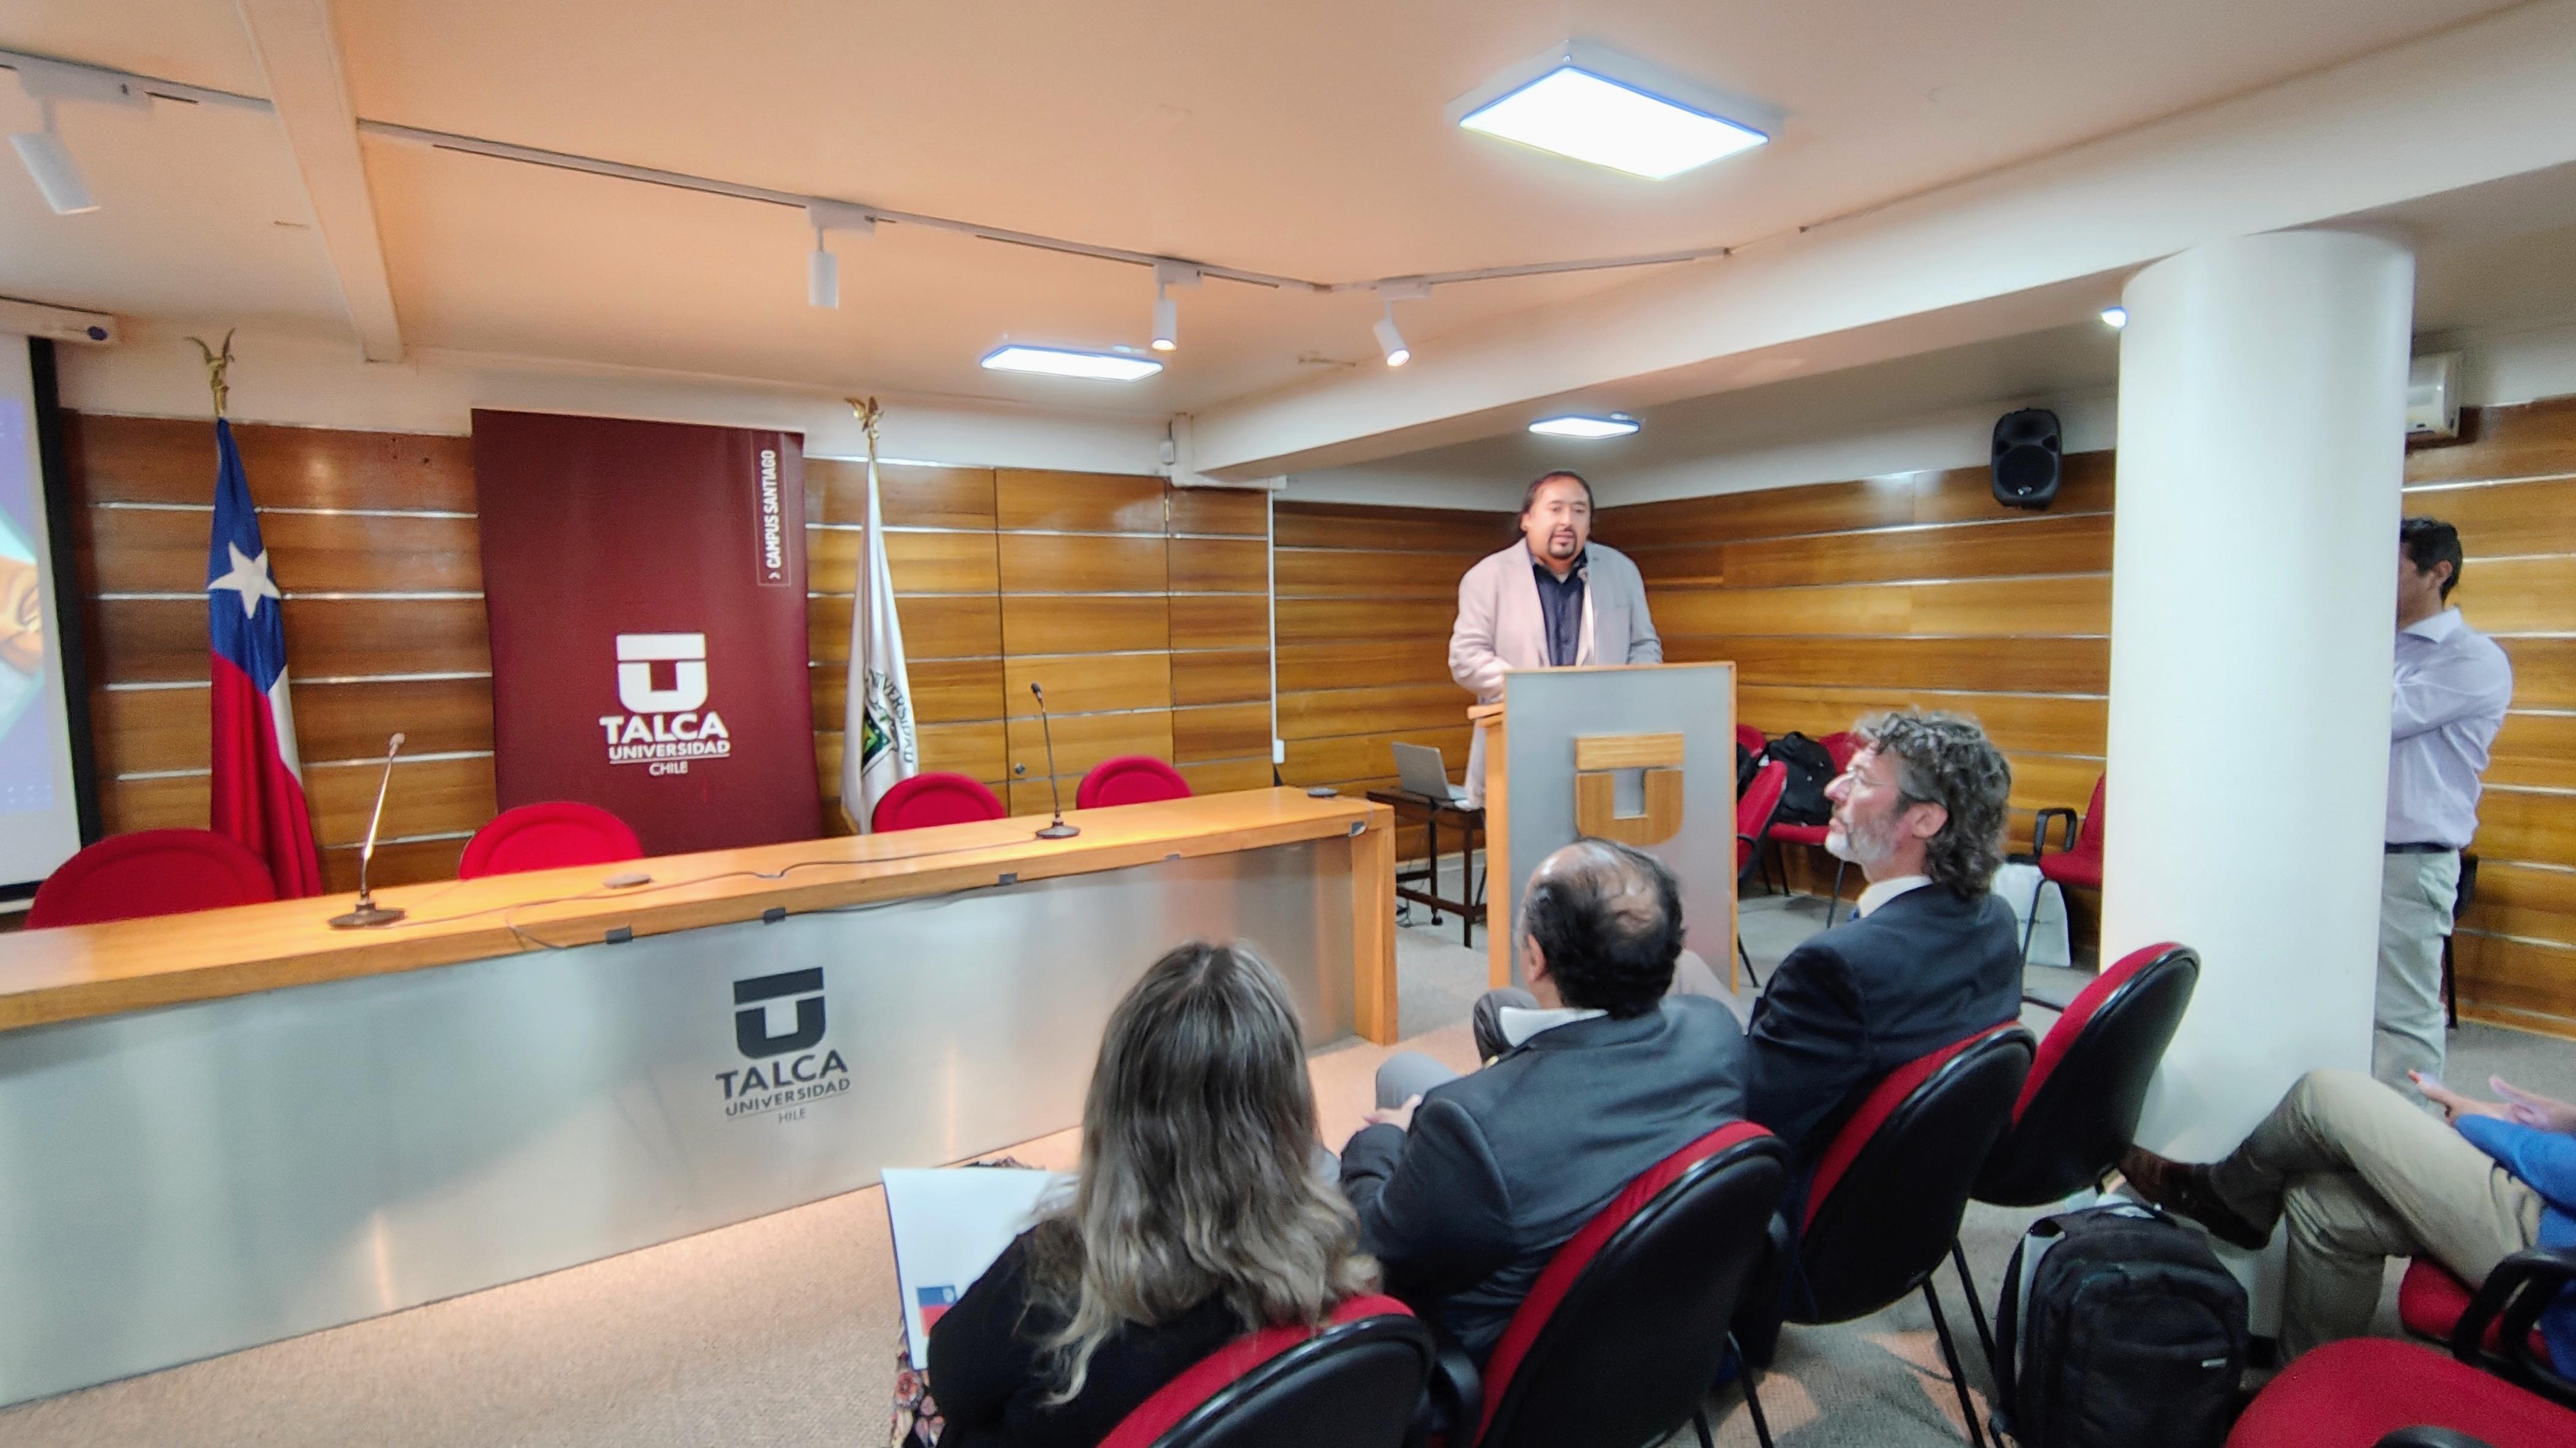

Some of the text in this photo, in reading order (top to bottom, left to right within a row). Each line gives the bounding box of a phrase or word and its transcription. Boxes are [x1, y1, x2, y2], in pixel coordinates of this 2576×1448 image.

[760, 450, 781, 569] CAMPUS SANTIAGO
[599, 711, 728, 744] TALCA
[608, 740, 730, 760] UNIVERSIDAD
[649, 761, 688, 776] CHILE
[715, 1049, 848, 1100] TALCA
[725, 1077, 850, 1116] UNIVERSIDAD
[778, 1108, 807, 1124] HILE
